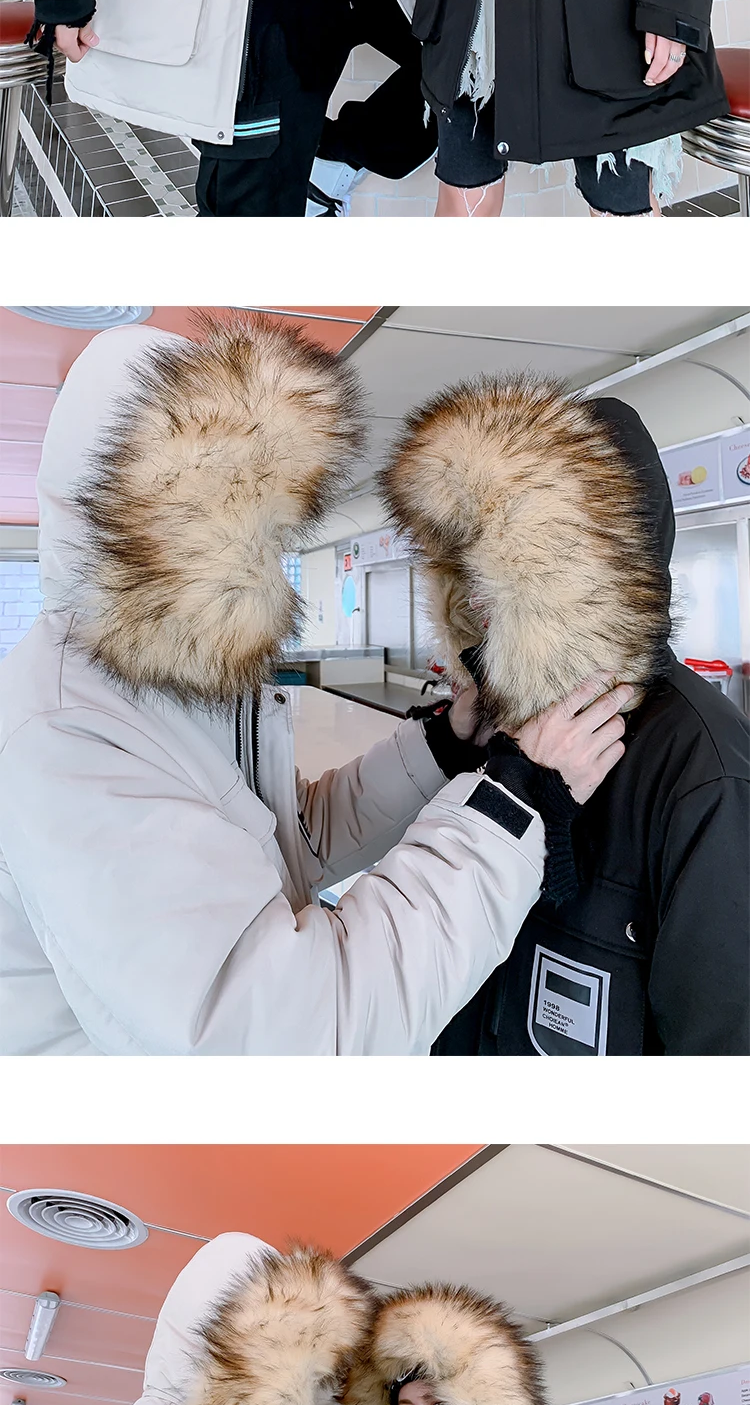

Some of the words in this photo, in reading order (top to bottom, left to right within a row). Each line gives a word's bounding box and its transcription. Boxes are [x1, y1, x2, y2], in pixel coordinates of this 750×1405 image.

[543, 999, 560, 1012] 1998
[542, 1006, 575, 1025] WONDERFUL
[548, 1021, 569, 1035] HOMME
